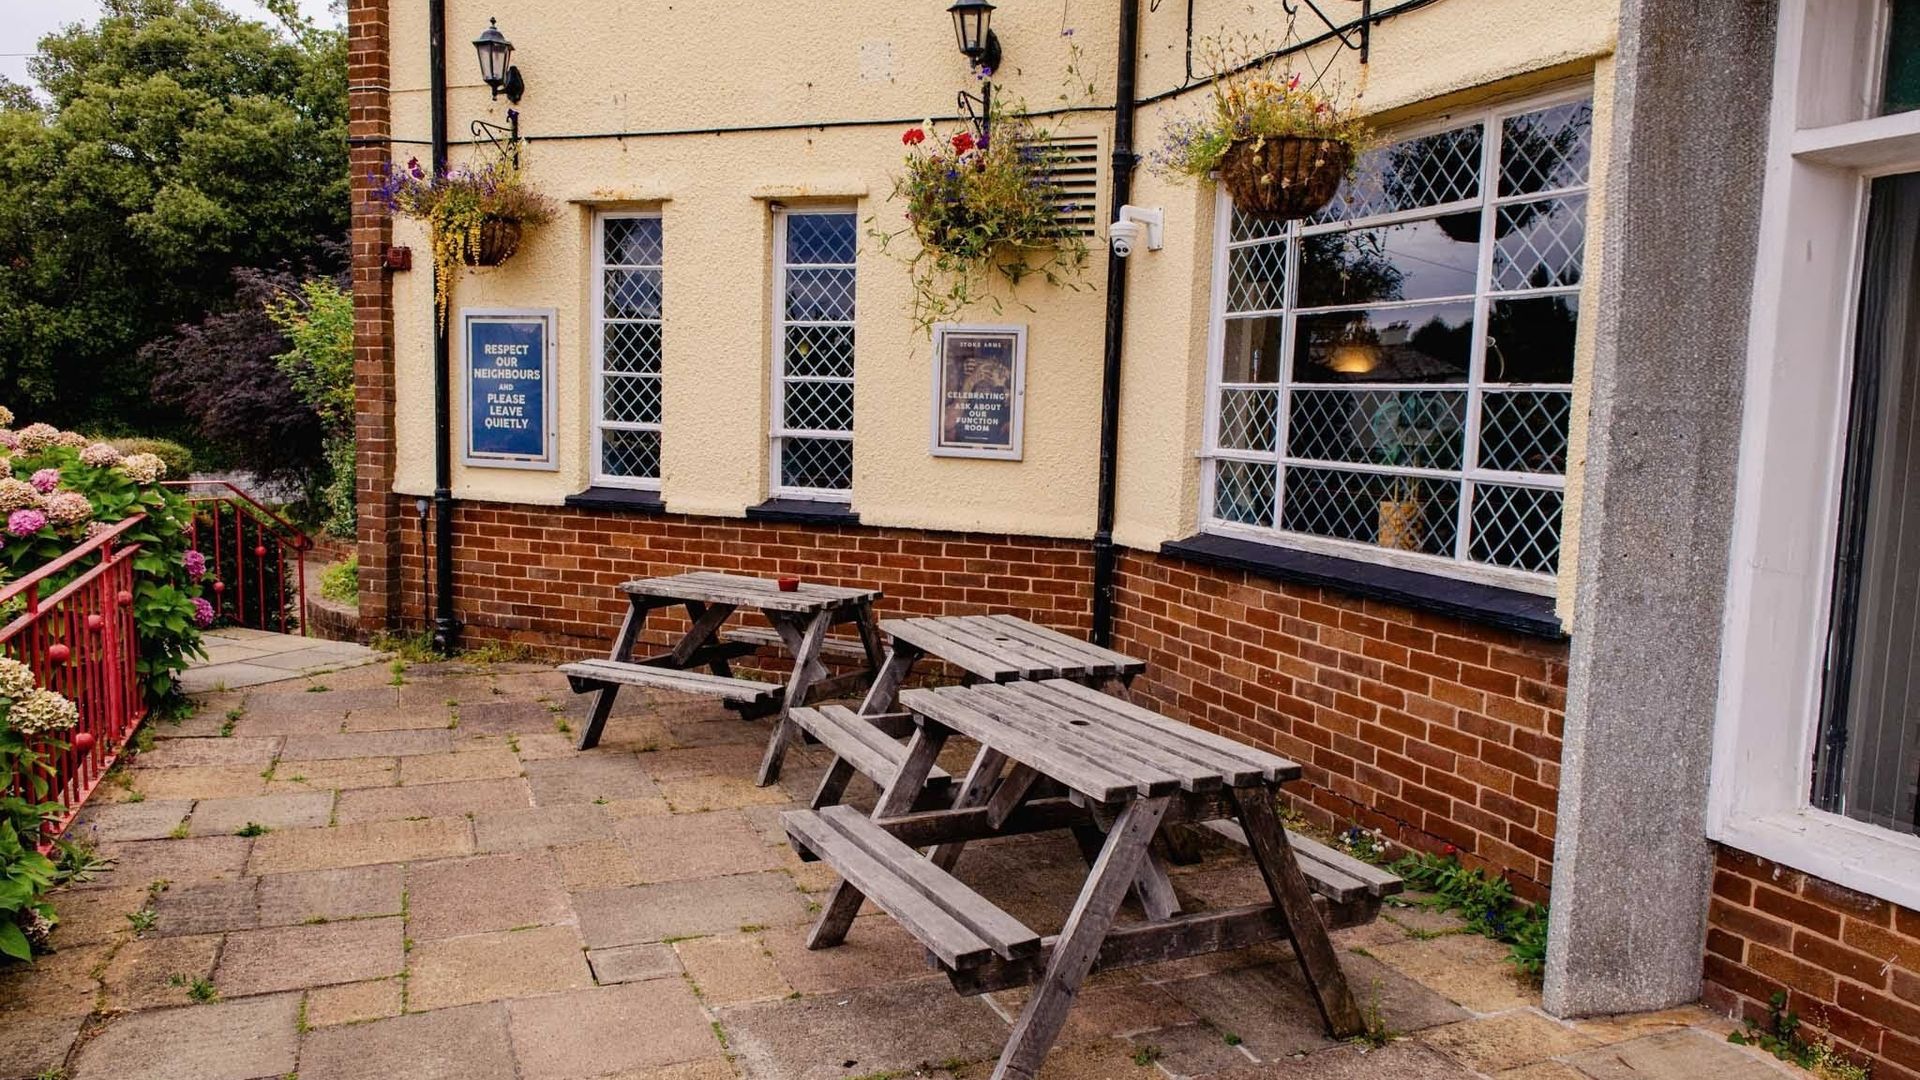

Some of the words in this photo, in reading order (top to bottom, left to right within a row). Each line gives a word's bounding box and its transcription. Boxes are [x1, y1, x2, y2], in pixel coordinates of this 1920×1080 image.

[484, 344, 529, 354] RESPECT
[496, 356, 518, 367] OUR
[474, 369, 541, 380] NEIGHBOURS
[498, 383, 514, 391] AND
[487, 393, 526, 404] PLEASE
[947, 391, 1009, 400] CELEBRATING?
[489, 406, 523, 416] LEAVE
[973, 403, 1001, 411] ABOUT
[484, 418, 529, 429] QUIETLY
[956, 417, 999, 425] FUNCTION
[964, 424, 990, 432] ROOM
